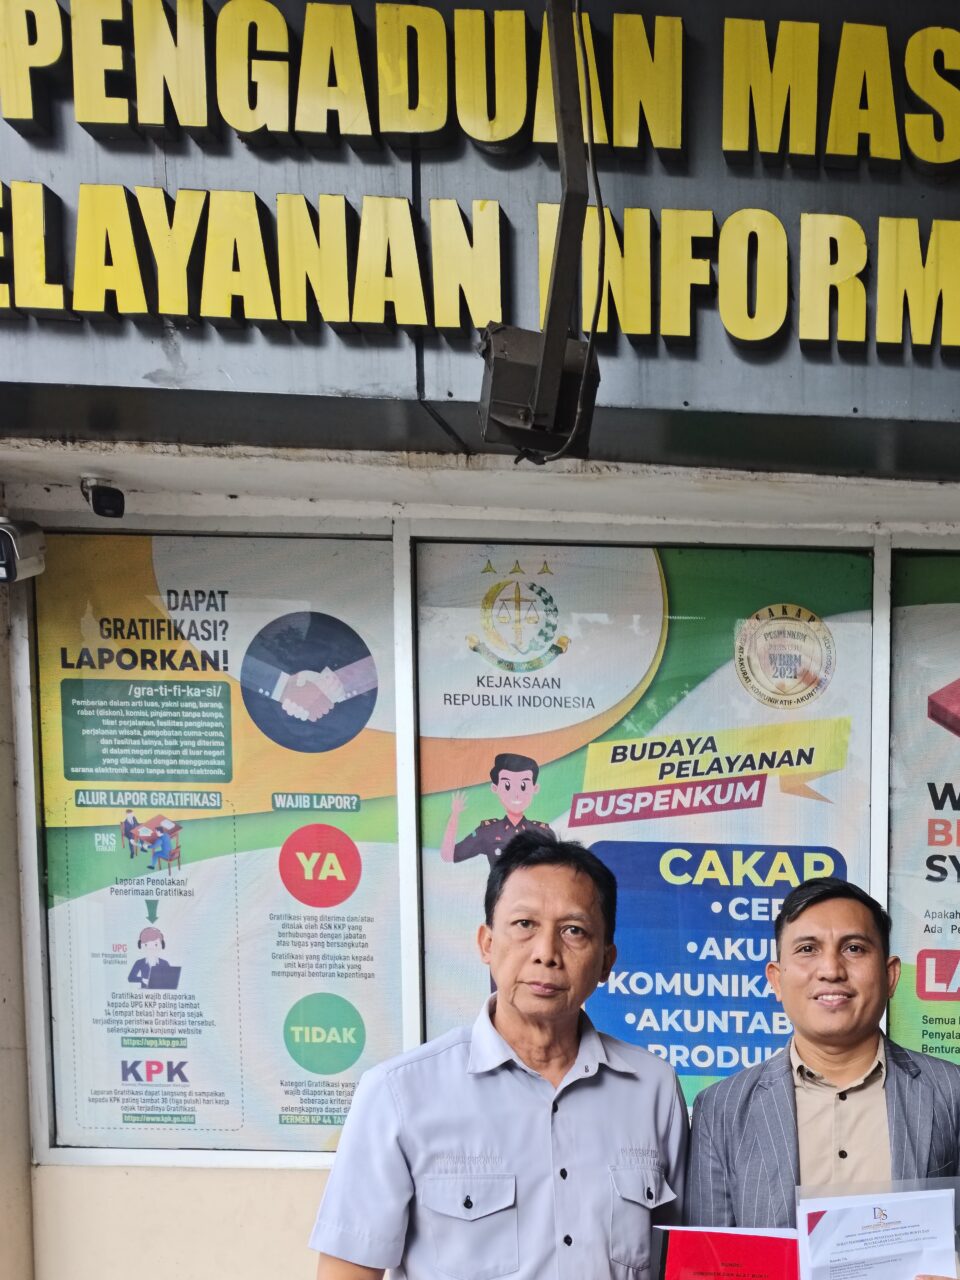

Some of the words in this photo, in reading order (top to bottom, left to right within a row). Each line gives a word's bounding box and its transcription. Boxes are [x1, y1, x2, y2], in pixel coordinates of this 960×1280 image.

[0, 0, 683, 150] PENGADUAN
[0, 181, 502, 327] LAYANAN
[167, 589, 228, 612] DAPAT
[100, 618, 228, 642] GRATIFIKASI?
[61, 648, 229, 671] LAPORKAN!
[476, 675, 561, 689] KEJAKSAAN
[443, 694, 512, 707] REPUBLIK
[517, 695, 595, 709] INDONESIA
[611, 736, 717, 764] BUDAYA
[659, 747, 815, 781] PELAYANAN
[78, 791, 107, 805] ALUR
[110, 792, 147, 806] LAPOR
[151, 793, 220, 807] GRATIFIKASI
[274, 794, 310, 808] WAJIB
[313, 795, 358, 809] LAPOR?
[573, 781, 761, 821] PUSPENKUM
[94, 833, 116, 846] PNS
[296, 852, 347, 881] YA
[924, 910, 960, 920] Apakah
[924, 925, 943, 934] Ada
[699, 937, 779, 961] AKU
[922, 1015, 956, 1025] Semua
[290, 1026, 357, 1044] TIDAK
[121, 1060, 189, 1082] KPK
